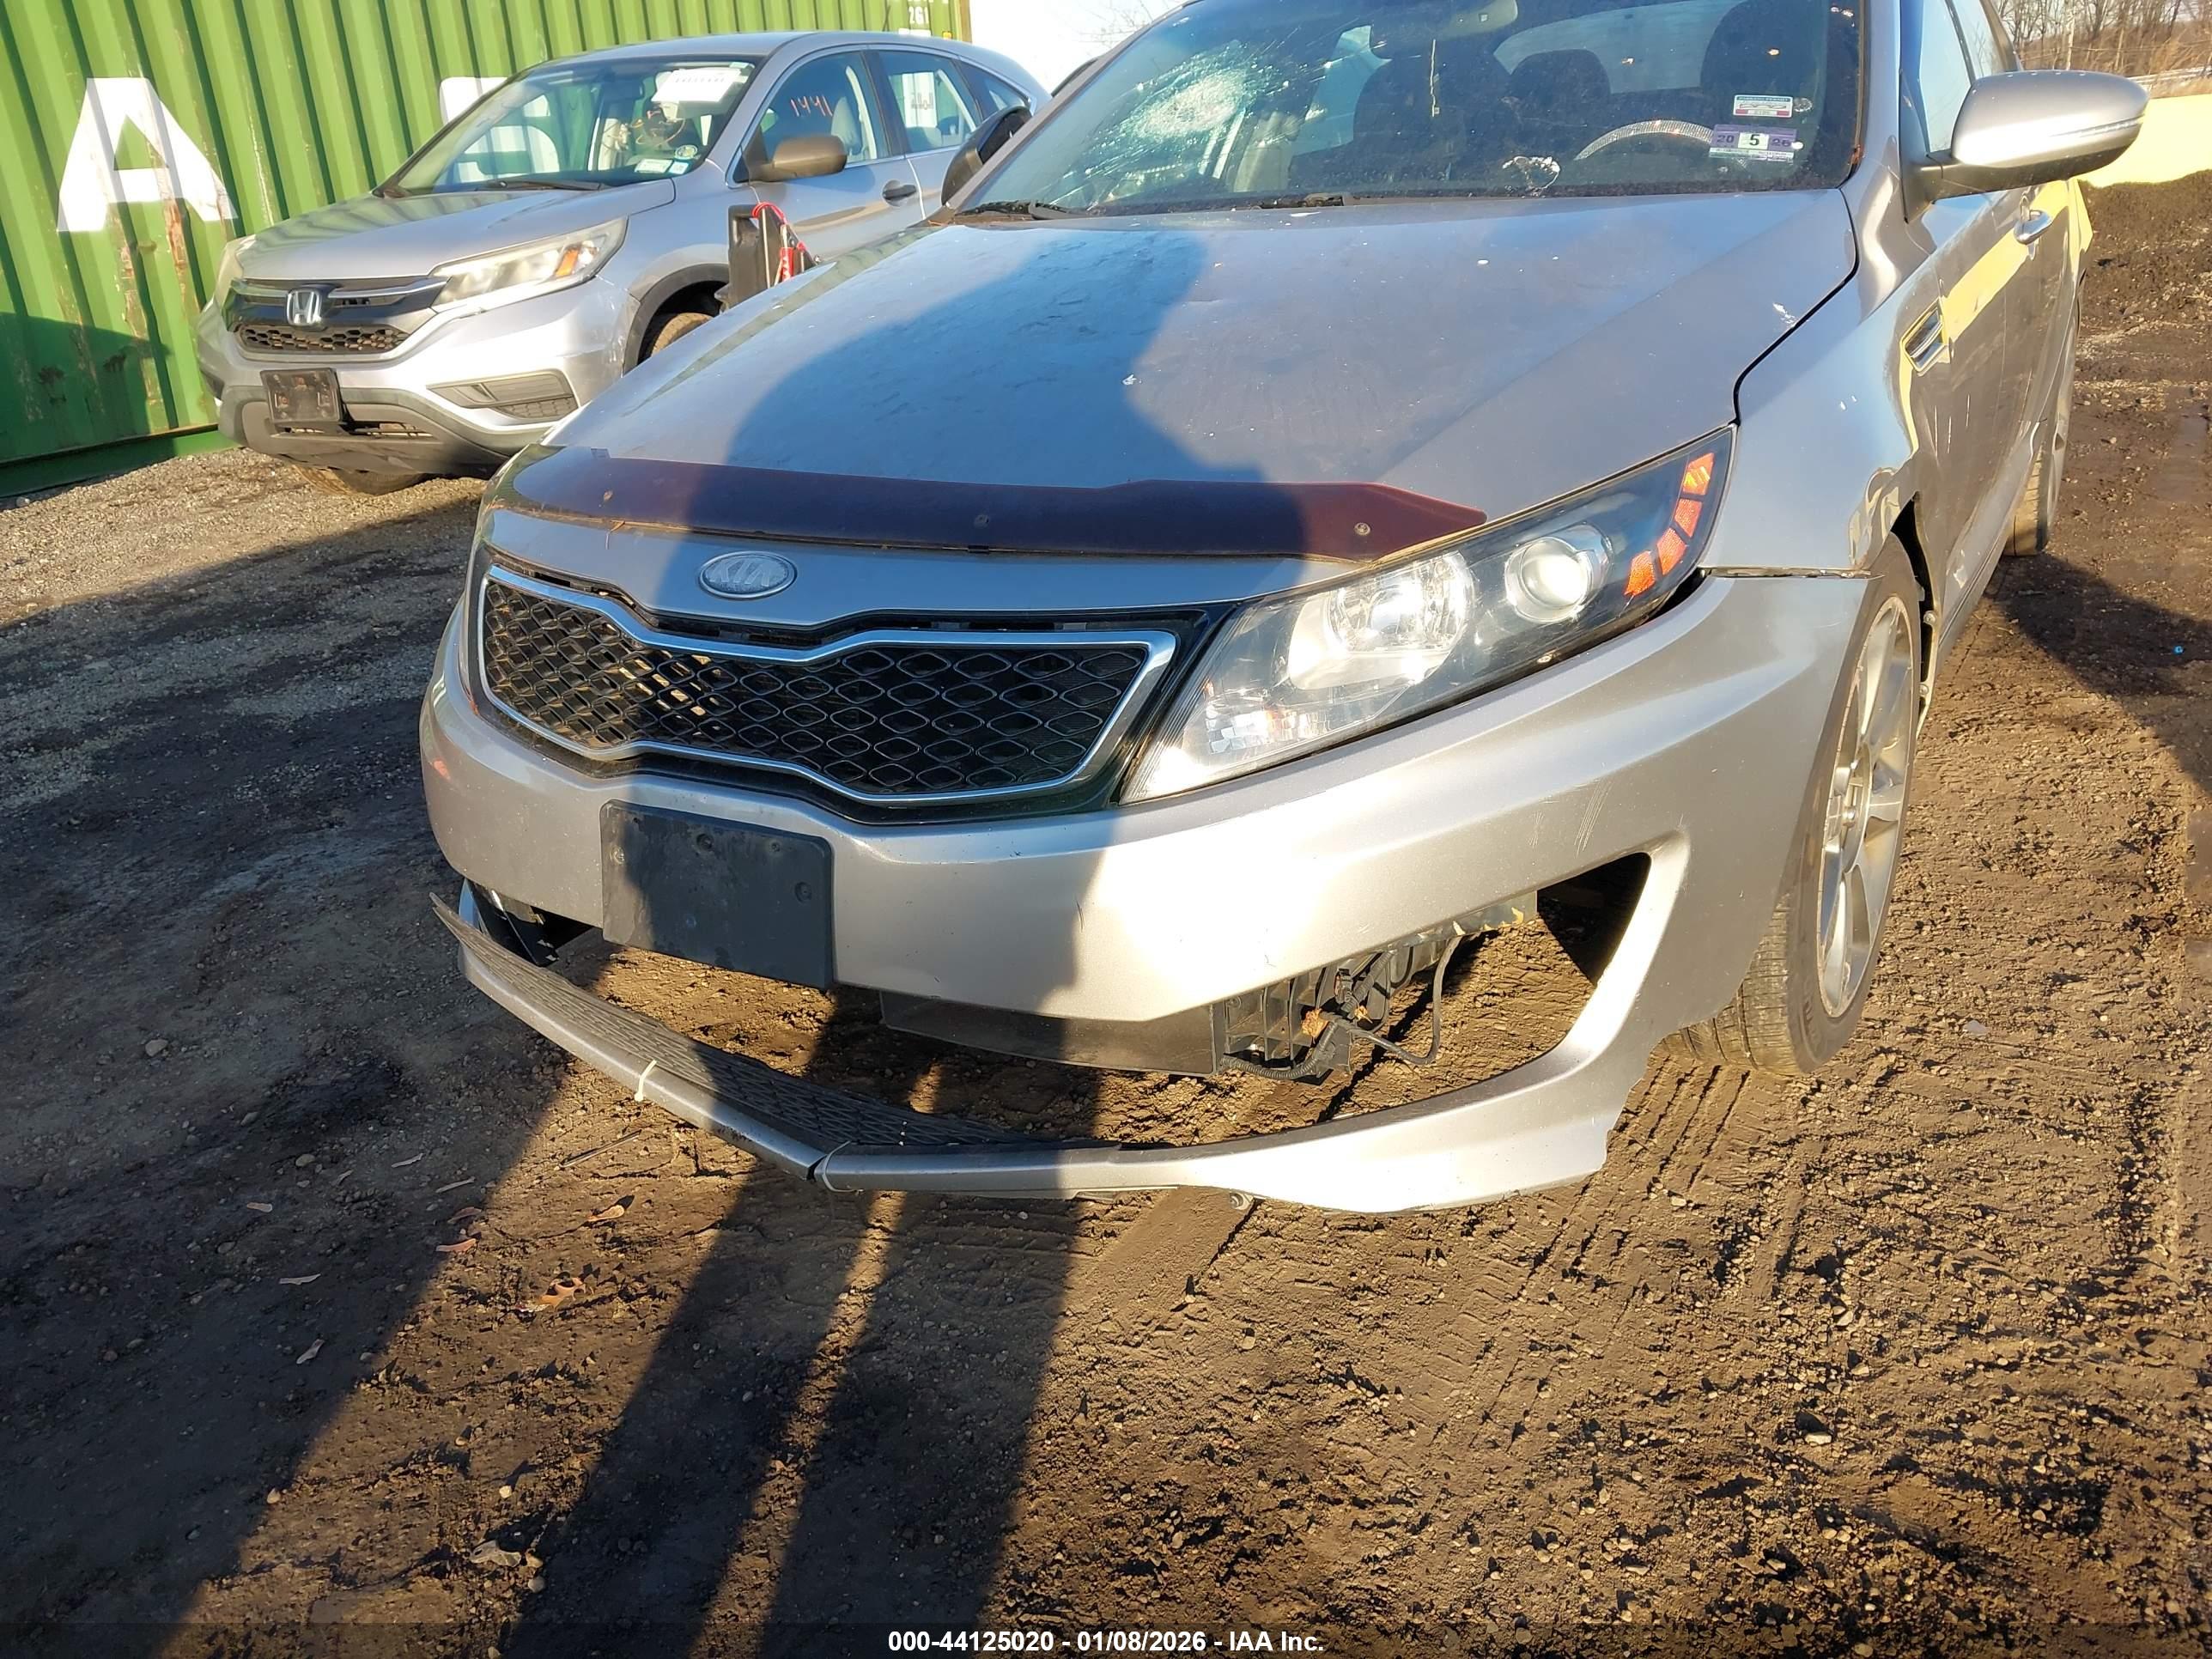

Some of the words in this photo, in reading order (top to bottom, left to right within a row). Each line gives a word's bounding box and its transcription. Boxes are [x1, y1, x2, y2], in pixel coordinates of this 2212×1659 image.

[57, 77, 239, 232] A
[1717, 135, 1735, 143] 20
[1748, 134, 1760, 146] 5
